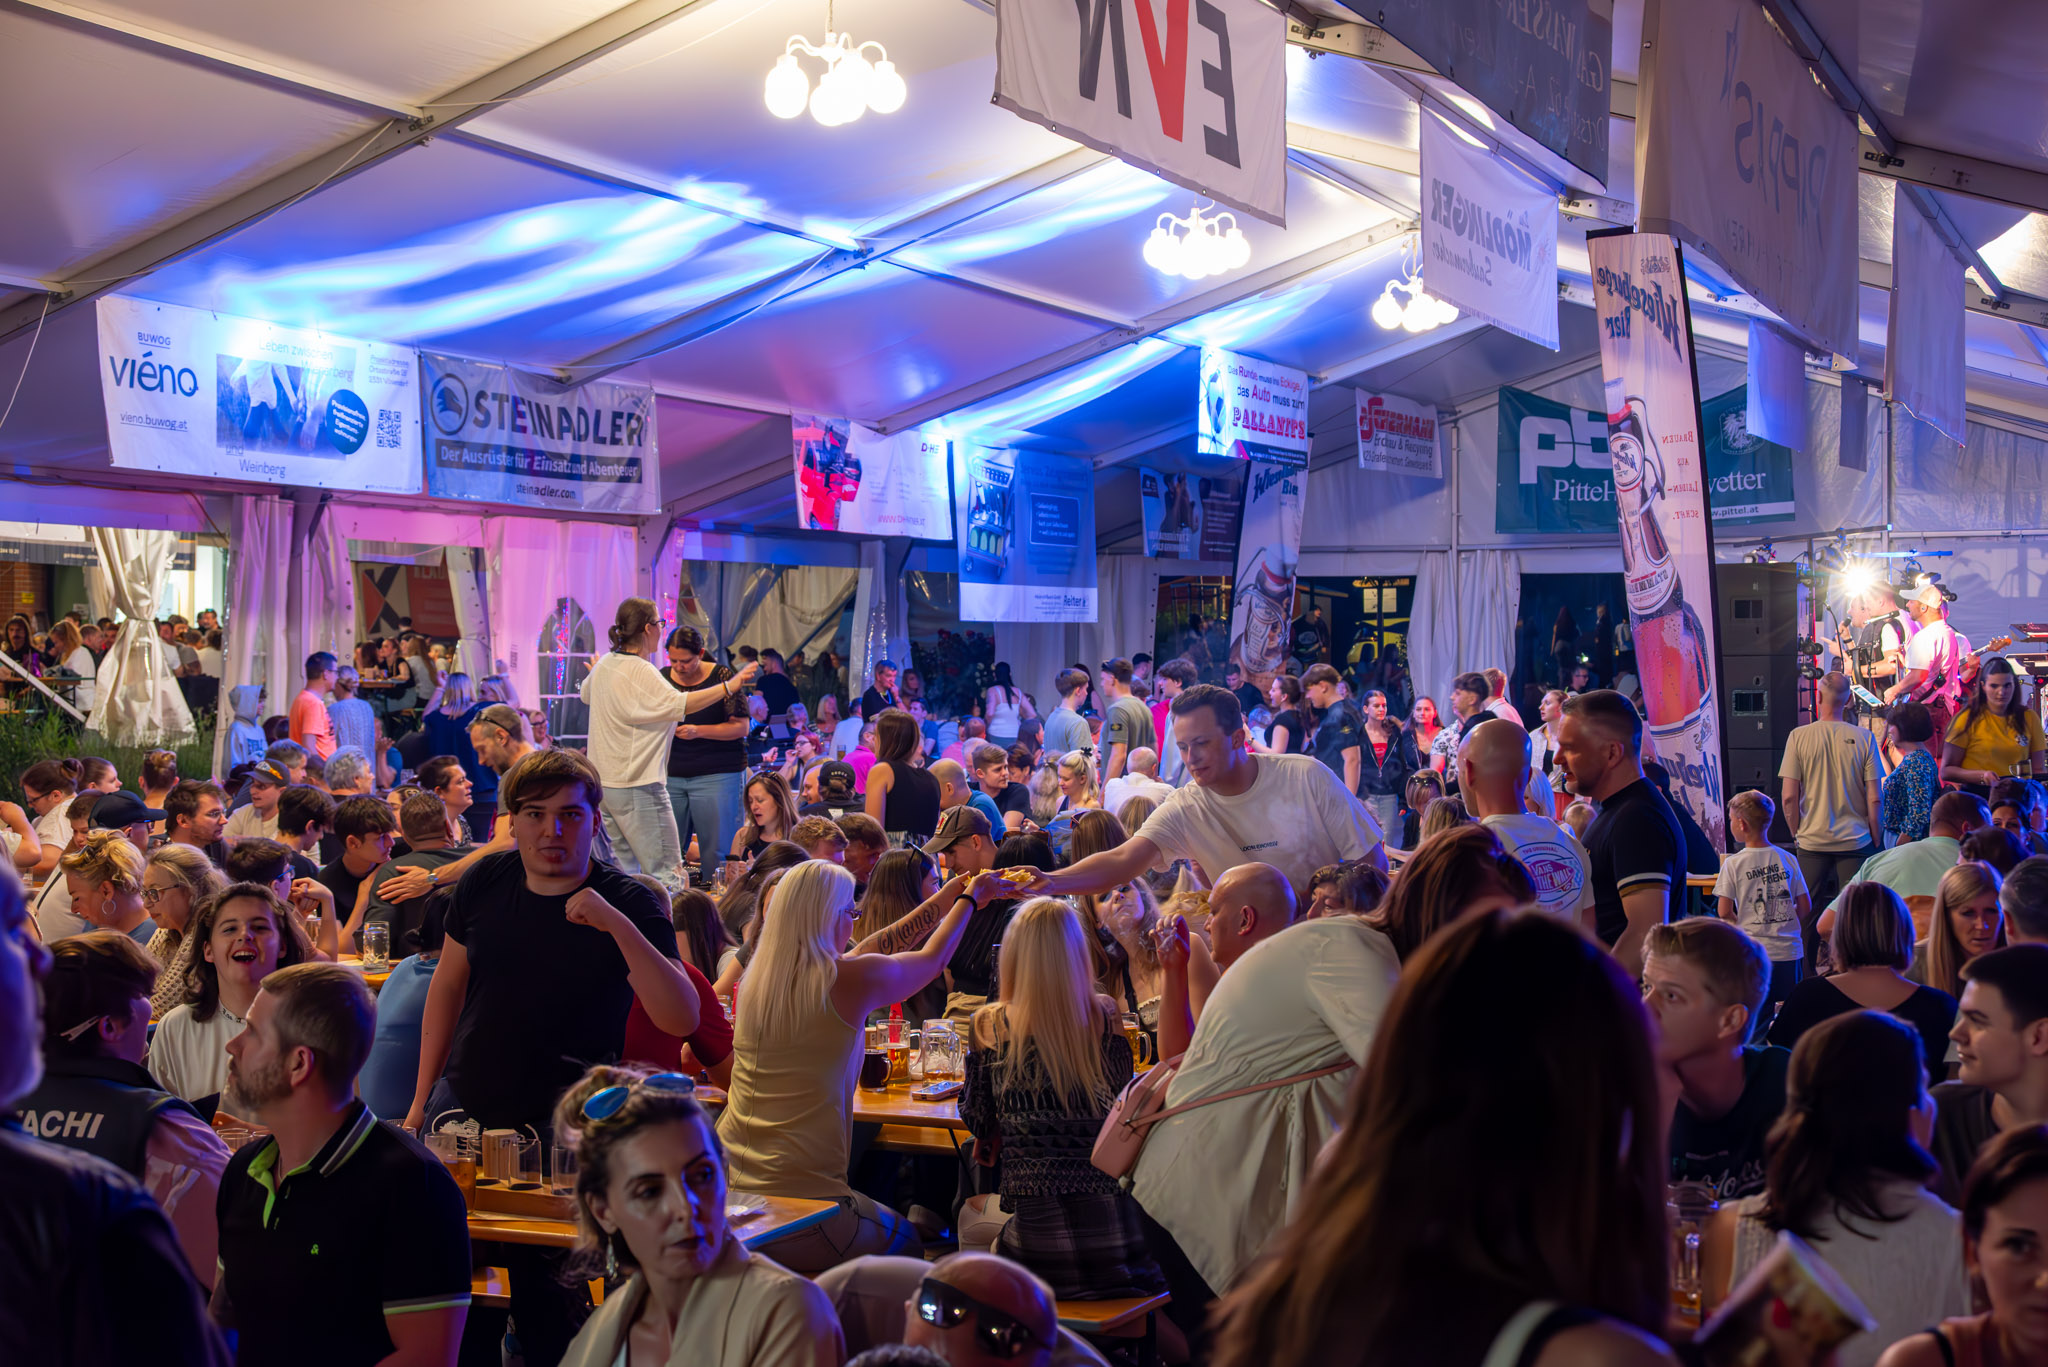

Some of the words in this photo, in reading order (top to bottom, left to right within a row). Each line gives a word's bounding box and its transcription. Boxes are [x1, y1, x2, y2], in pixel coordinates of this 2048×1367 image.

[137, 332, 171, 346] BUWOG
[260, 342, 289, 353] Leben
[109, 350, 198, 398] viéno
[1227, 365, 1239, 376] Das
[1239, 366, 1258, 381] Runde
[1259, 375, 1273, 384] muss
[1237, 385, 1250, 398] das
[1251, 384, 1271, 402] Auto
[1272, 395, 1291, 407] muss
[120, 411, 188, 431] vieno.buwog.at
[473, 389, 643, 447] STEINADLER
[225, 443, 244, 455] und
[240, 459, 286, 478] Weinberg
[440, 445, 461, 461] Der
[462, 449, 514, 467] Ausrüster
[514, 453, 531, 470] für
[533, 456, 572, 475] Einsatz
[588, 463, 638, 478] Abenteuer
[516, 483, 577, 500] steinadler.com
[1531, 863, 1554, 877] VANS
[1746, 863, 1779, 880] DANCING
[1762, 870, 1790, 885] FRIENDS
[17, 1110, 104, 1138] ACHI
